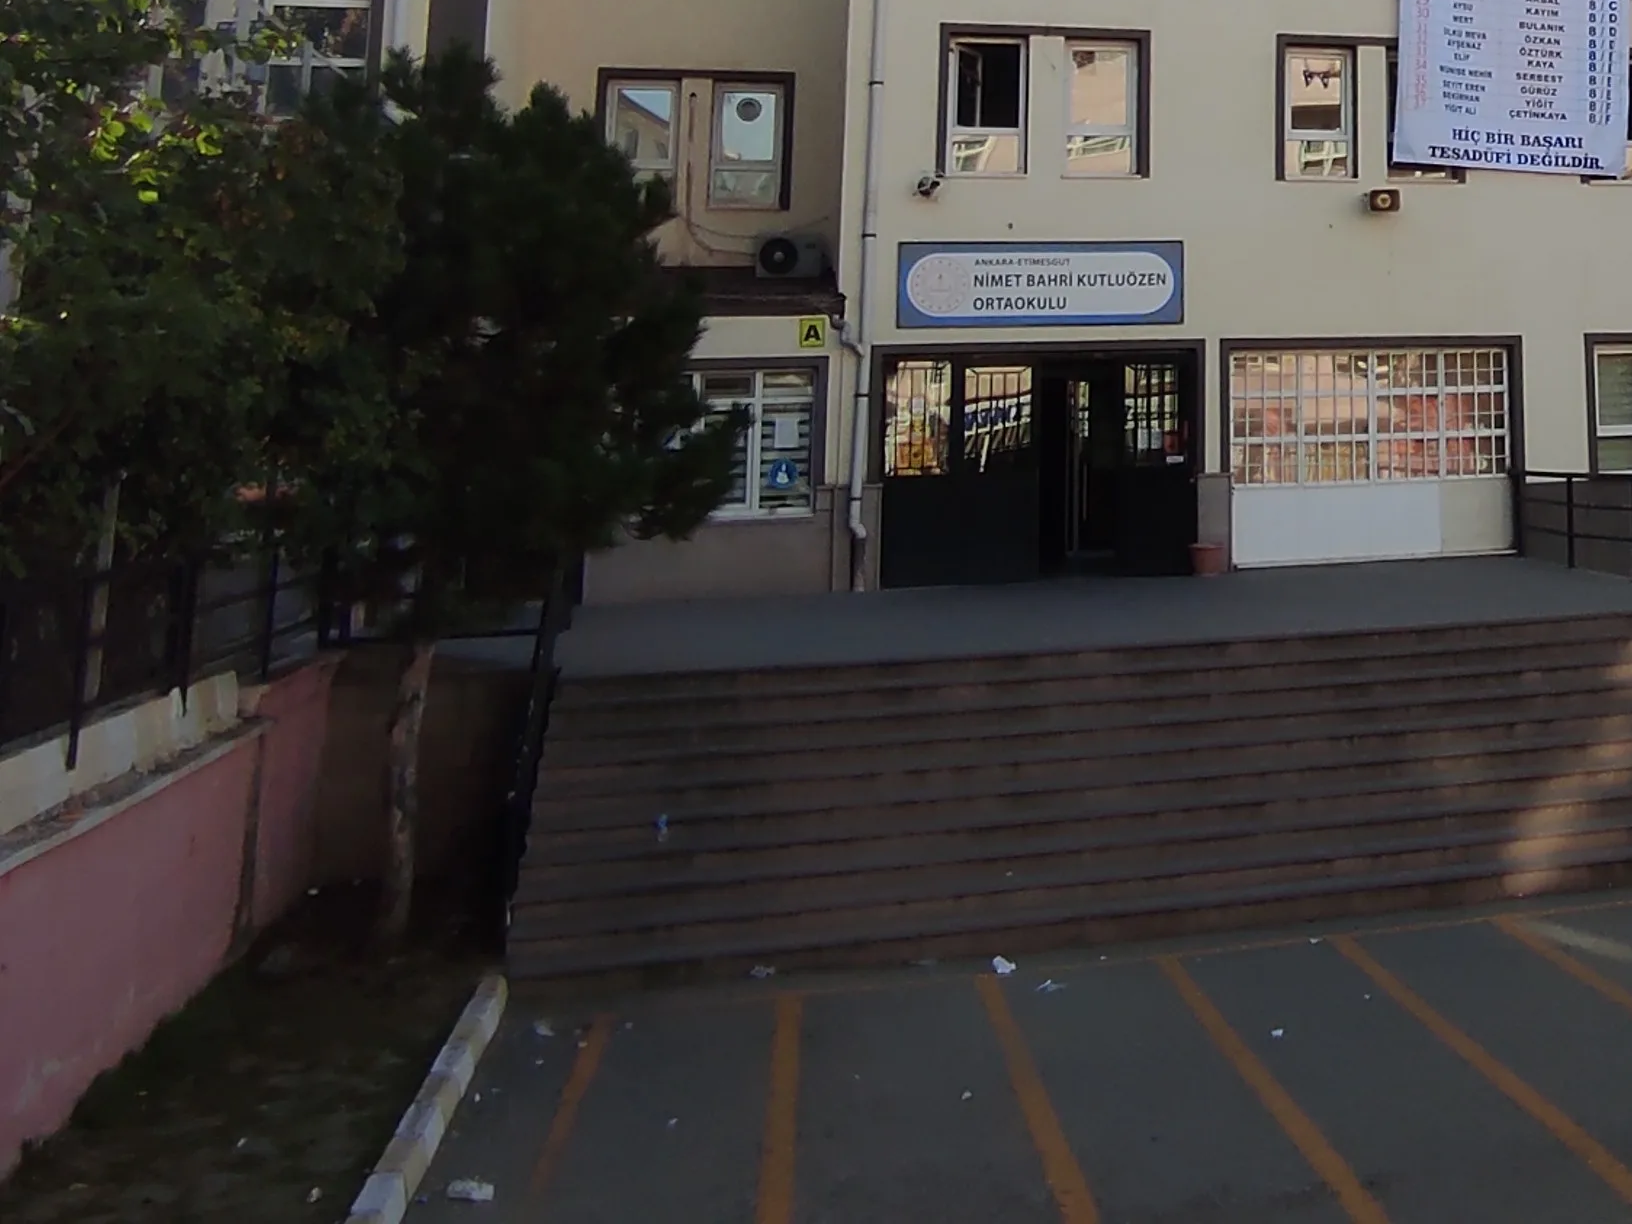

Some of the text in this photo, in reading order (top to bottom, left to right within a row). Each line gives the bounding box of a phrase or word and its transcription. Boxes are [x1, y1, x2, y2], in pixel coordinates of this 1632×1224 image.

[1524, 34, 1560, 45] ÖZKAN
[1518, 46, 1561, 58] ÖZTÜRK
[1527, 59, 1554, 68] KAYA
[1515, 72, 1563, 83] SERBEST
[1524, 98, 1554, 108] YİĞİT
[1508, 108, 1567, 122] ÇETİNKAYA
[1452, 125, 1582, 150] HİÇ BİR BAŞARI
[1428, 143, 1604, 170] TESADÜFİ DEĞİLDİR.
[973, 271, 1167, 288] NİMET BAHRİ KUTLUÖZEN
[973, 297, 1067, 311] ORTAOKULU
[804, 324, 821, 341] A
